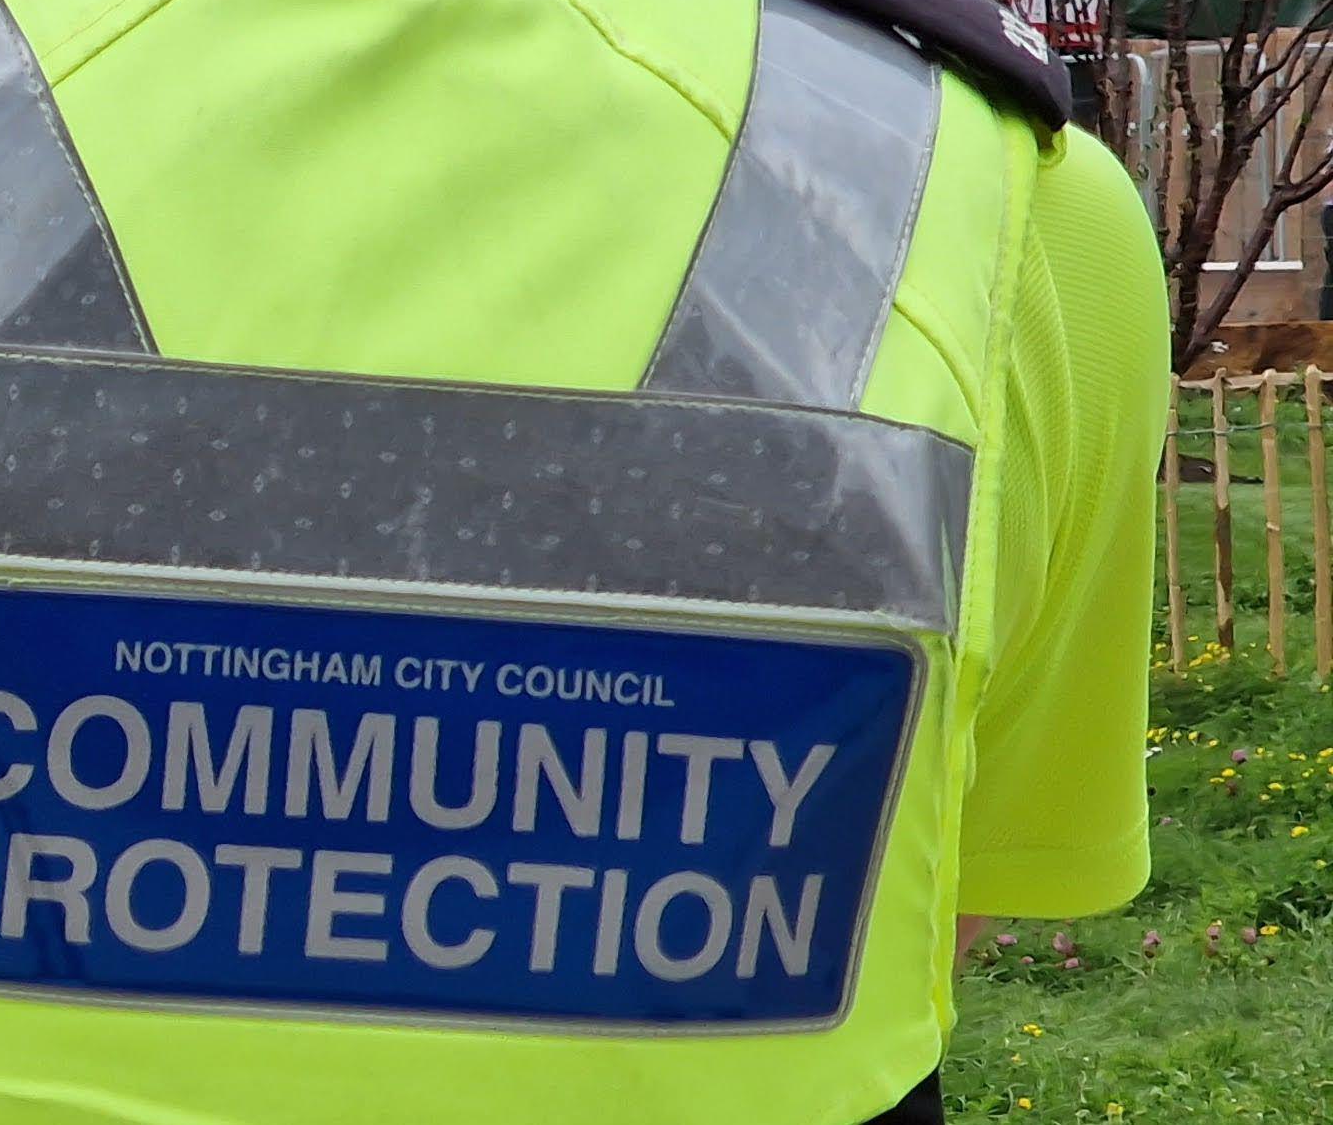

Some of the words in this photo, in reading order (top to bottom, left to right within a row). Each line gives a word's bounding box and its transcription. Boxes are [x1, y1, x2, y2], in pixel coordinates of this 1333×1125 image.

[115, 640, 381, 686] NOTTINGHAM
[393, 657, 485, 695] CITY
[497, 665, 676, 707] COUNCIL
